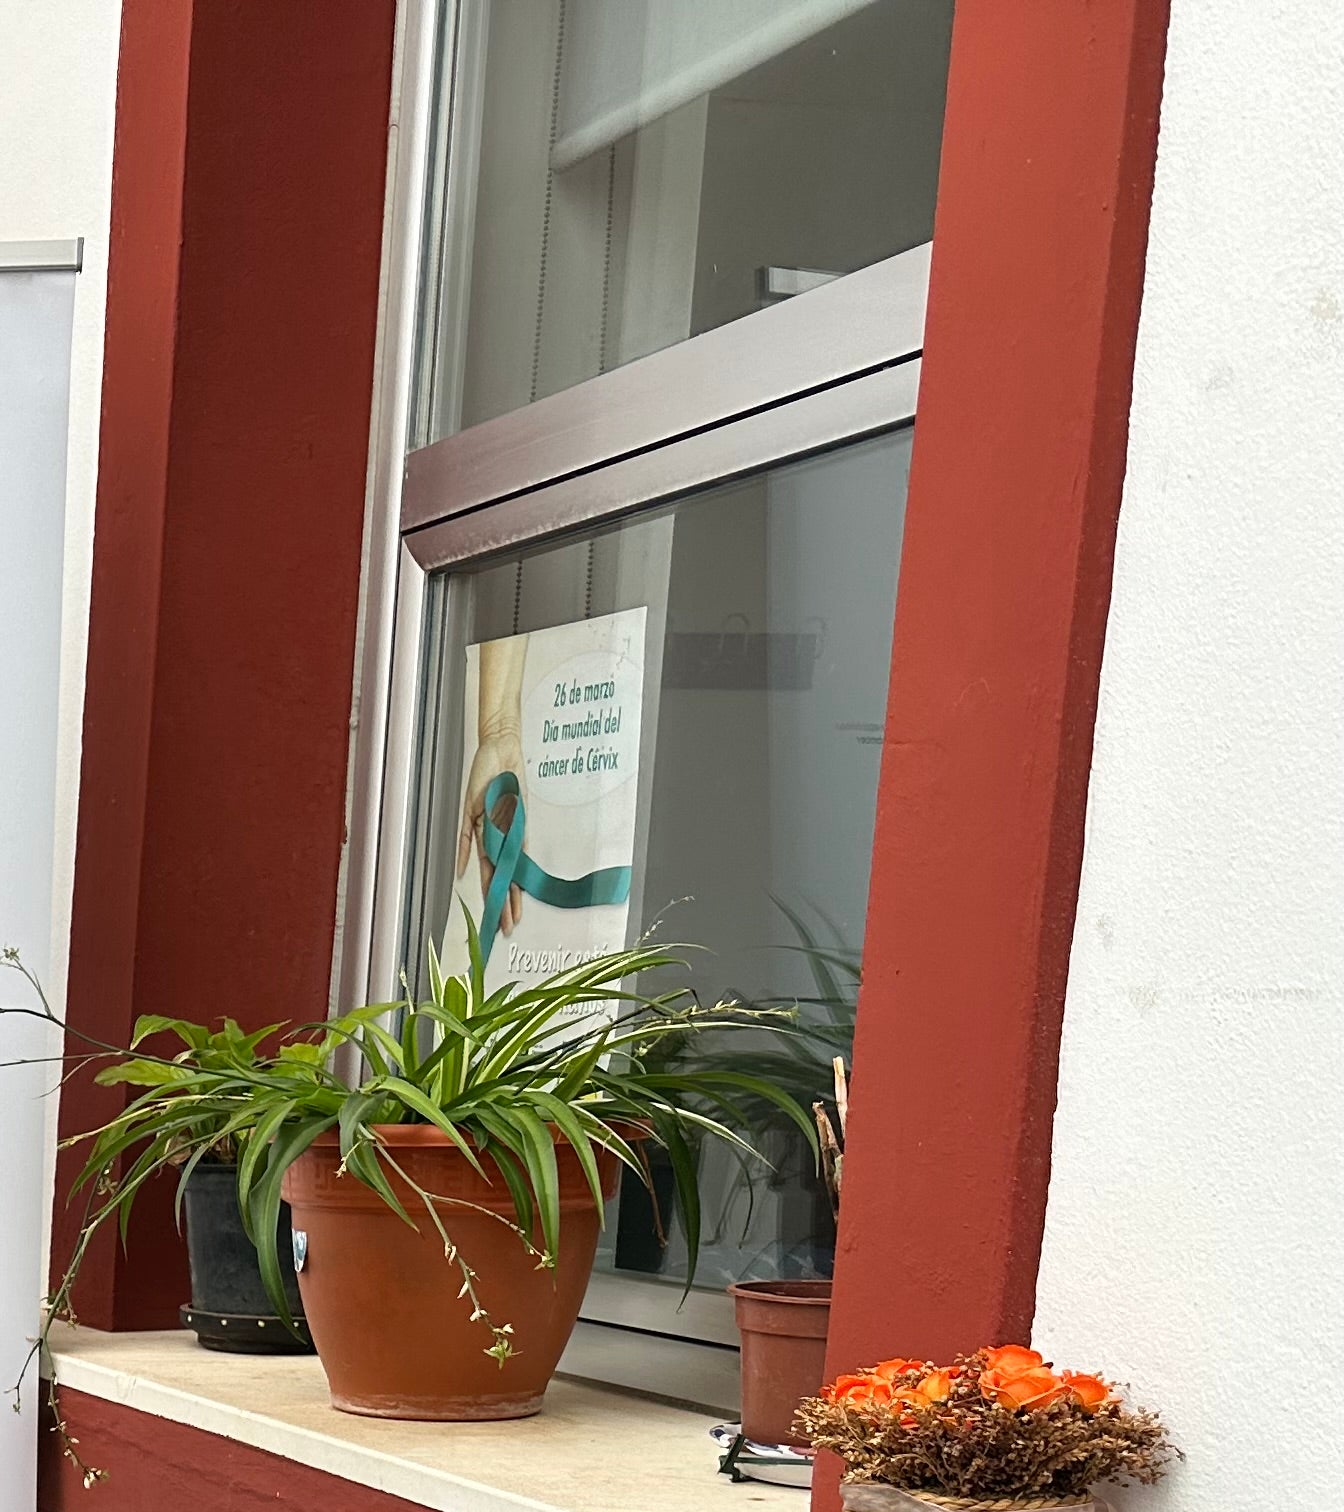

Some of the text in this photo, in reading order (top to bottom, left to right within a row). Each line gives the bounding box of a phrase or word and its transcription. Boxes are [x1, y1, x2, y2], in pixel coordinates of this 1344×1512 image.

[554, 678, 614, 707] 26 de marzo
[543, 706, 621, 743] Día mundial del
[539, 746, 618, 778] cáncer de Cérvix
[508, 943, 570, 973] Prevenir
